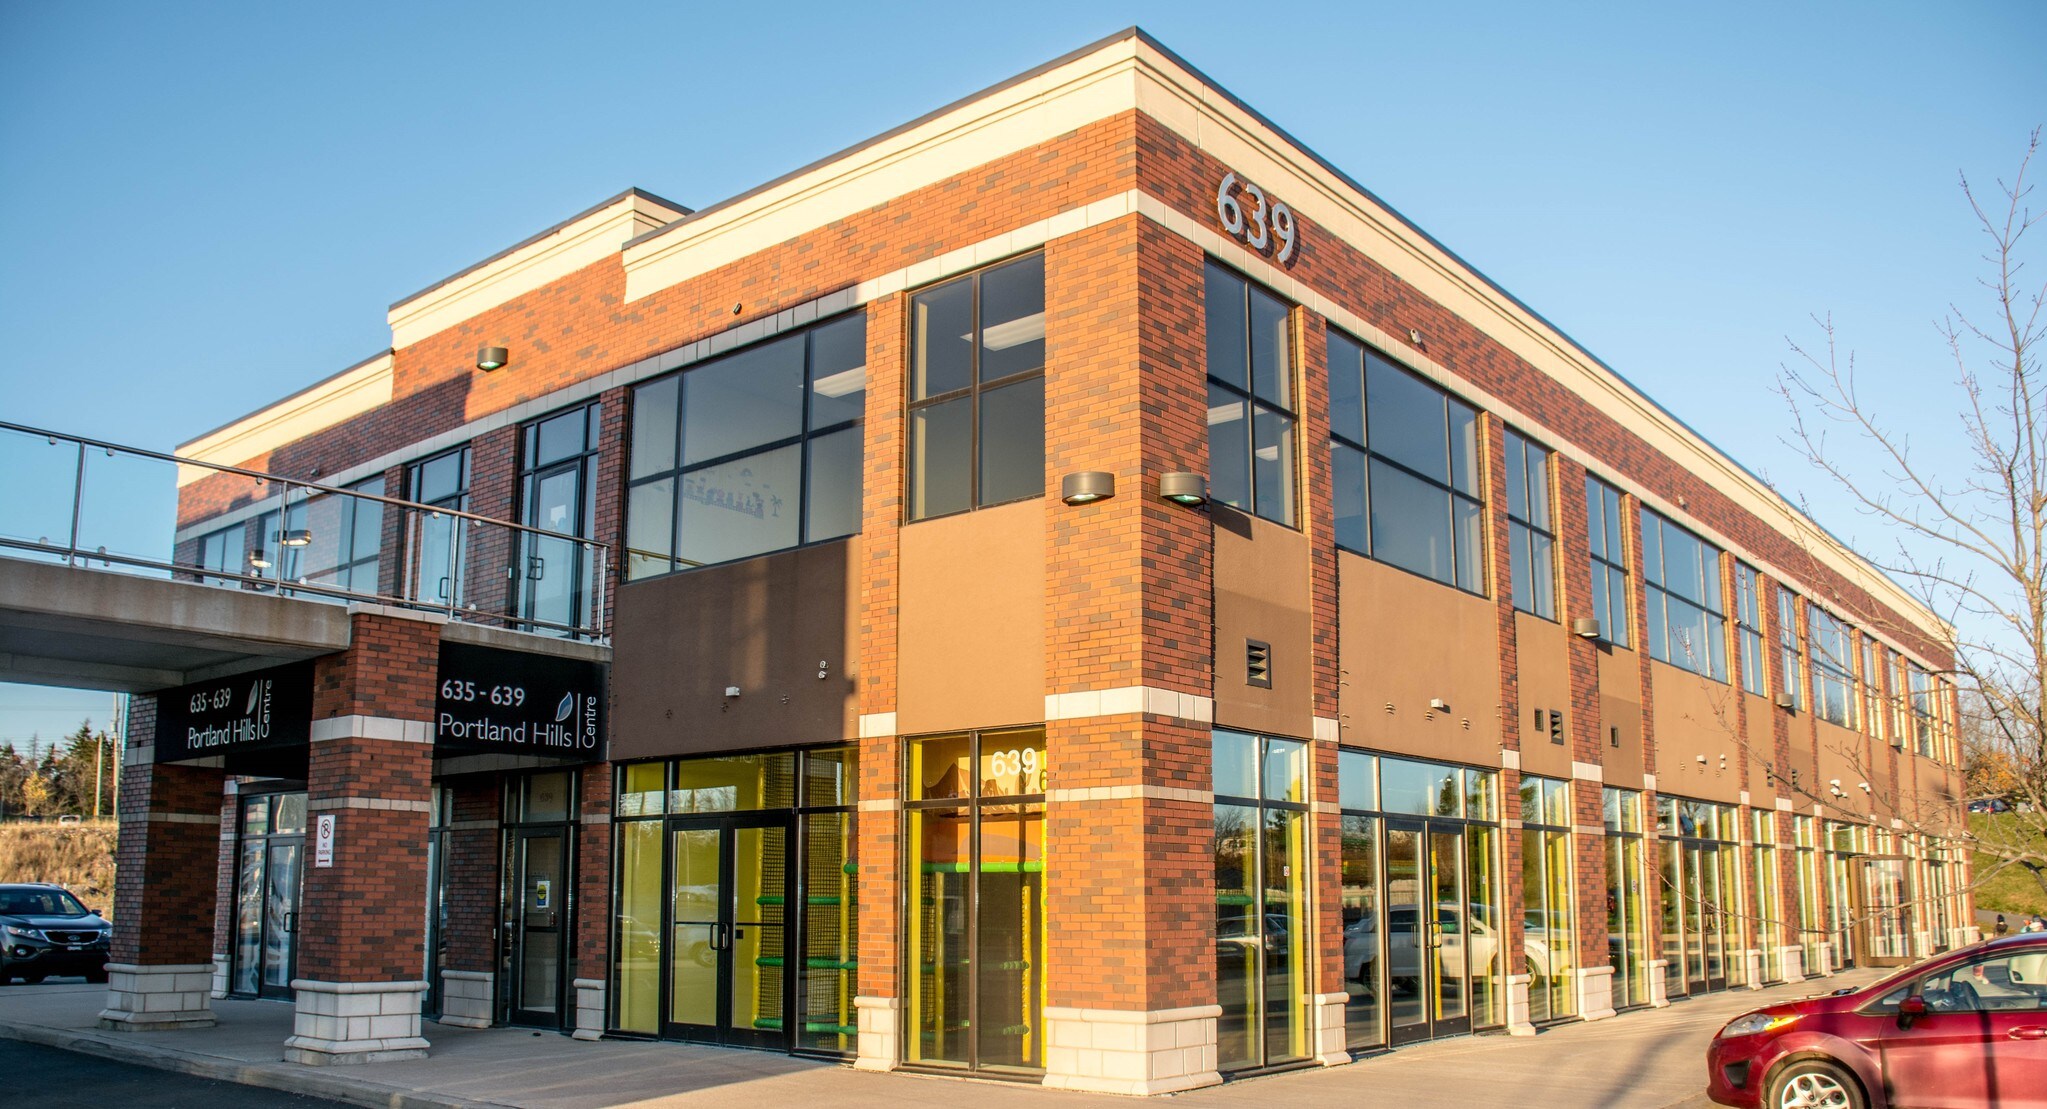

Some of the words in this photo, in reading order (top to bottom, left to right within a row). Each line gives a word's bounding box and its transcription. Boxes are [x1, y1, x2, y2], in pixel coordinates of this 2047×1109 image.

[1217, 172, 1294, 262] 639
[261, 680, 272, 738] Centre
[439, 712, 526, 743] Portland
[533, 722, 572, 747] Hills
[582, 696, 597, 749] Centre
[187, 721, 230, 749] Portland
[233, 718, 256, 742] Hills
[992, 747, 1037, 777] 639
